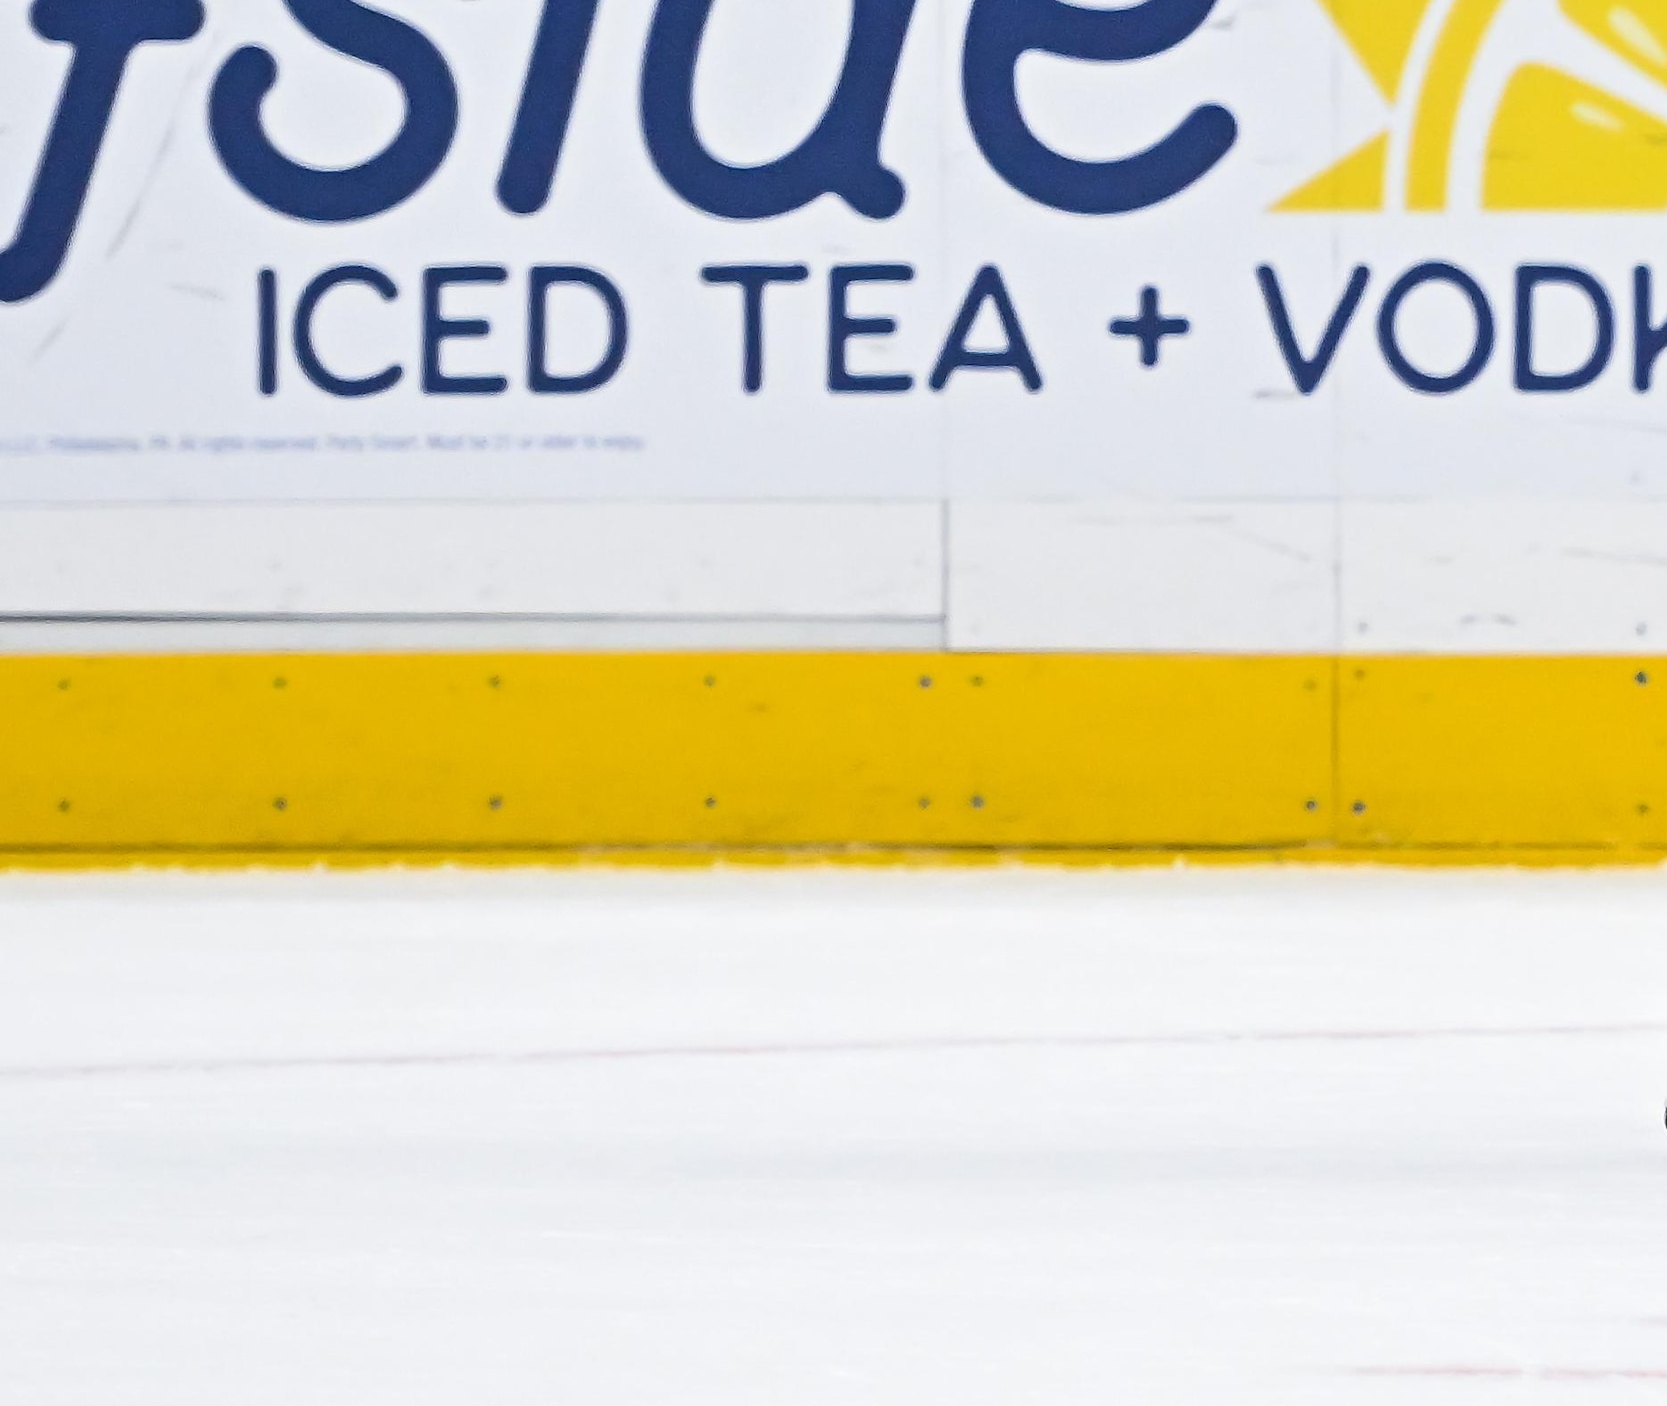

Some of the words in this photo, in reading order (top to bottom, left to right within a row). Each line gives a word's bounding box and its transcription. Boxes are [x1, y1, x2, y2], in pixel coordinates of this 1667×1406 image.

[258, 264, 628, 398] ICED
[701, 263, 1042, 394] TEA
[1109, 286, 1190, 367] +
